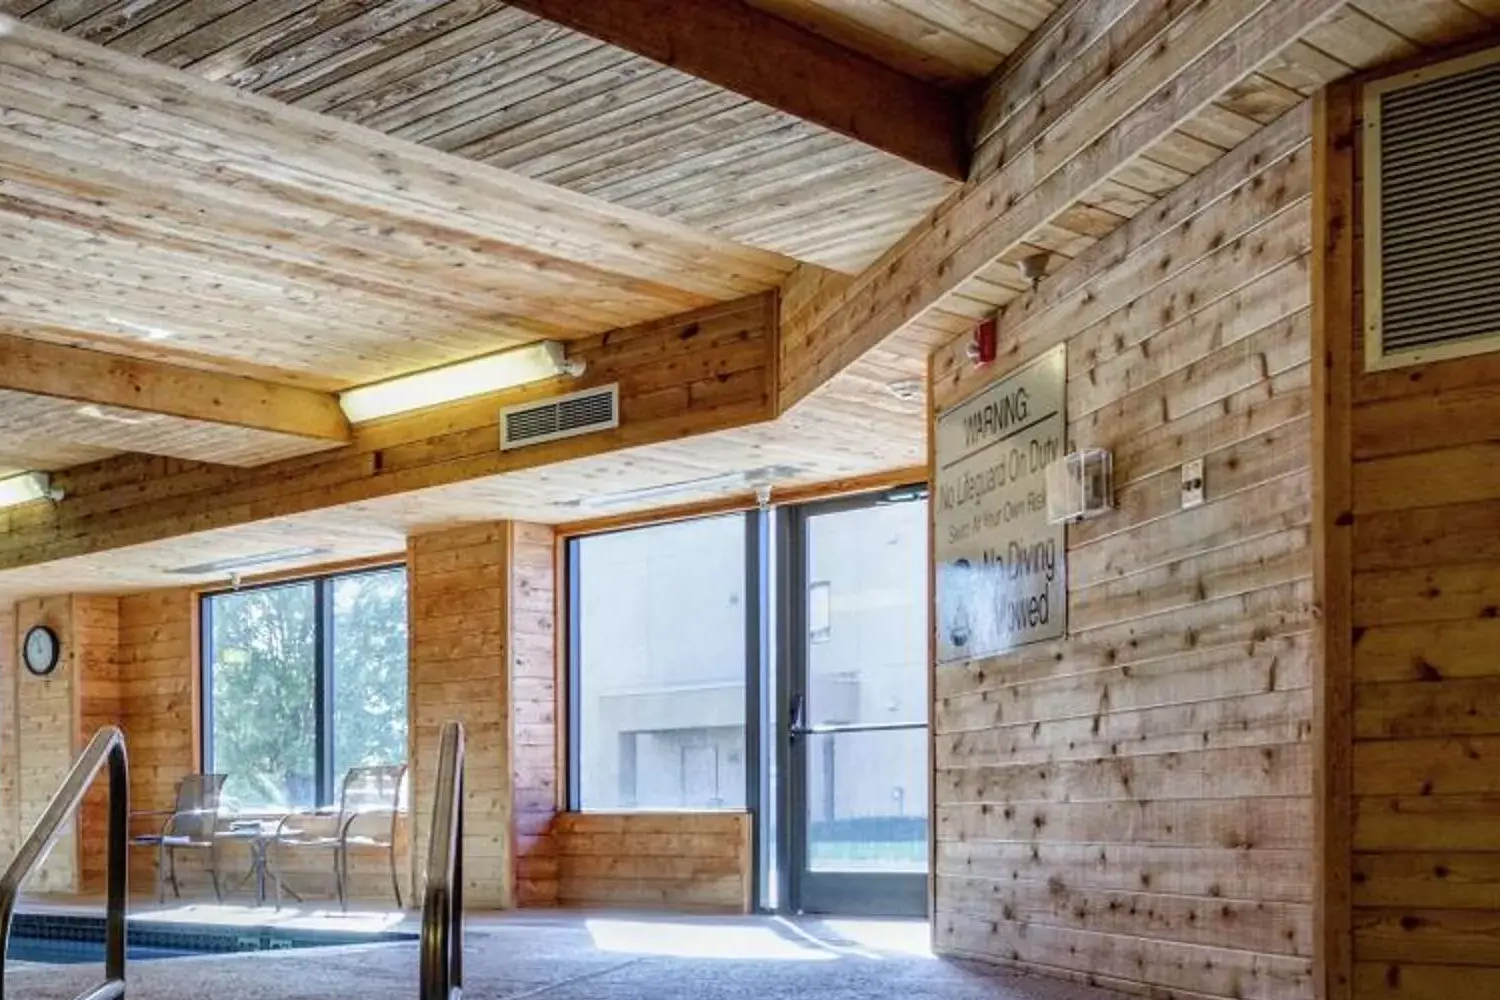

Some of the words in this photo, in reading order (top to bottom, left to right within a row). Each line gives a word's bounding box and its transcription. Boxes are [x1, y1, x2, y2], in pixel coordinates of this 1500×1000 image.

[964, 387, 1030, 447] WARNING
[1009, 447, 1028, 482] On
[1030, 435, 1059, 474] Duty
[1007, 538, 1055, 582] Diving
